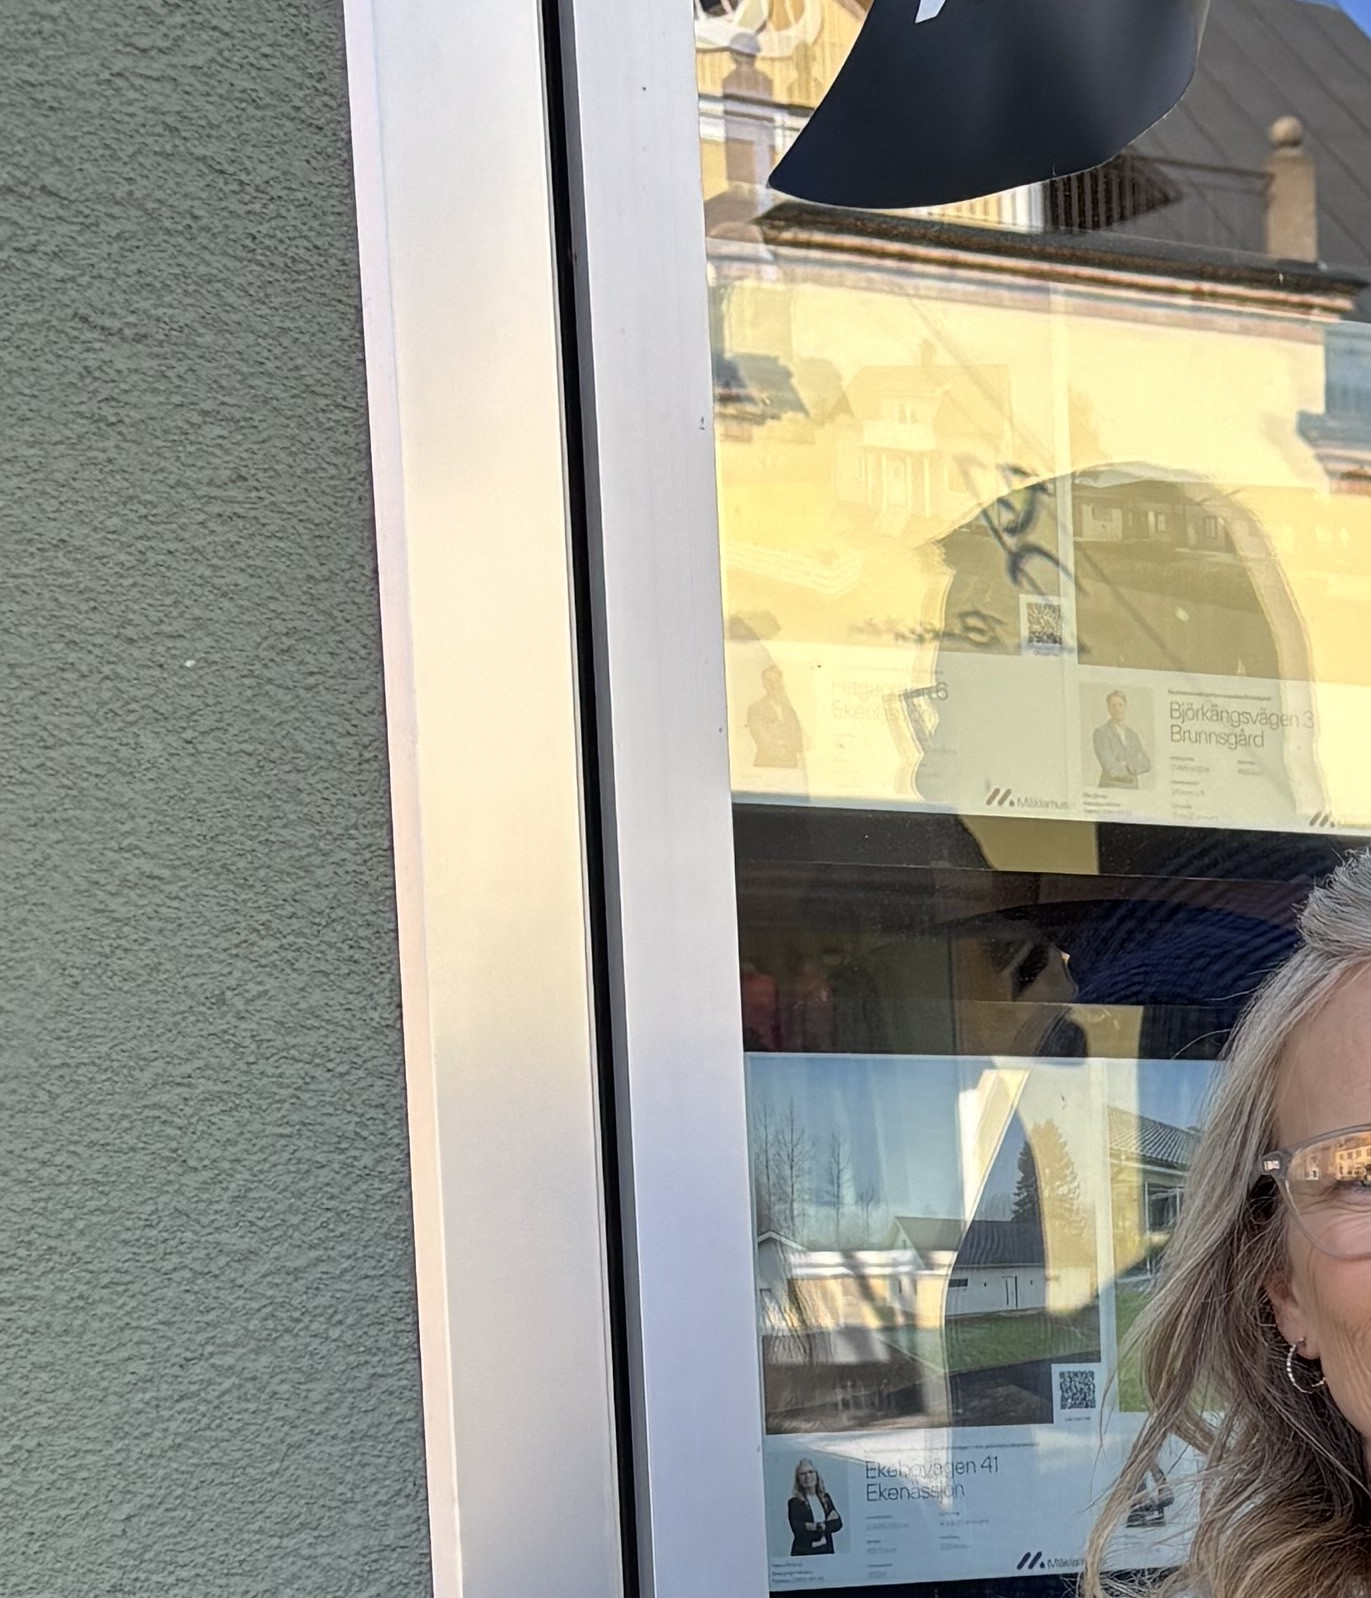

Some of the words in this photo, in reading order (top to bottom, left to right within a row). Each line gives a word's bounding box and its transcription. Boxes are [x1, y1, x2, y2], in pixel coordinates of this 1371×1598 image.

[1169, 700, 1301, 730] Björkängsvägen
[1302, 710, 1315, 729] 3
[1170, 724, 1265, 750] Brunnsgård
[980, 1456, 1000, 1474] 41
